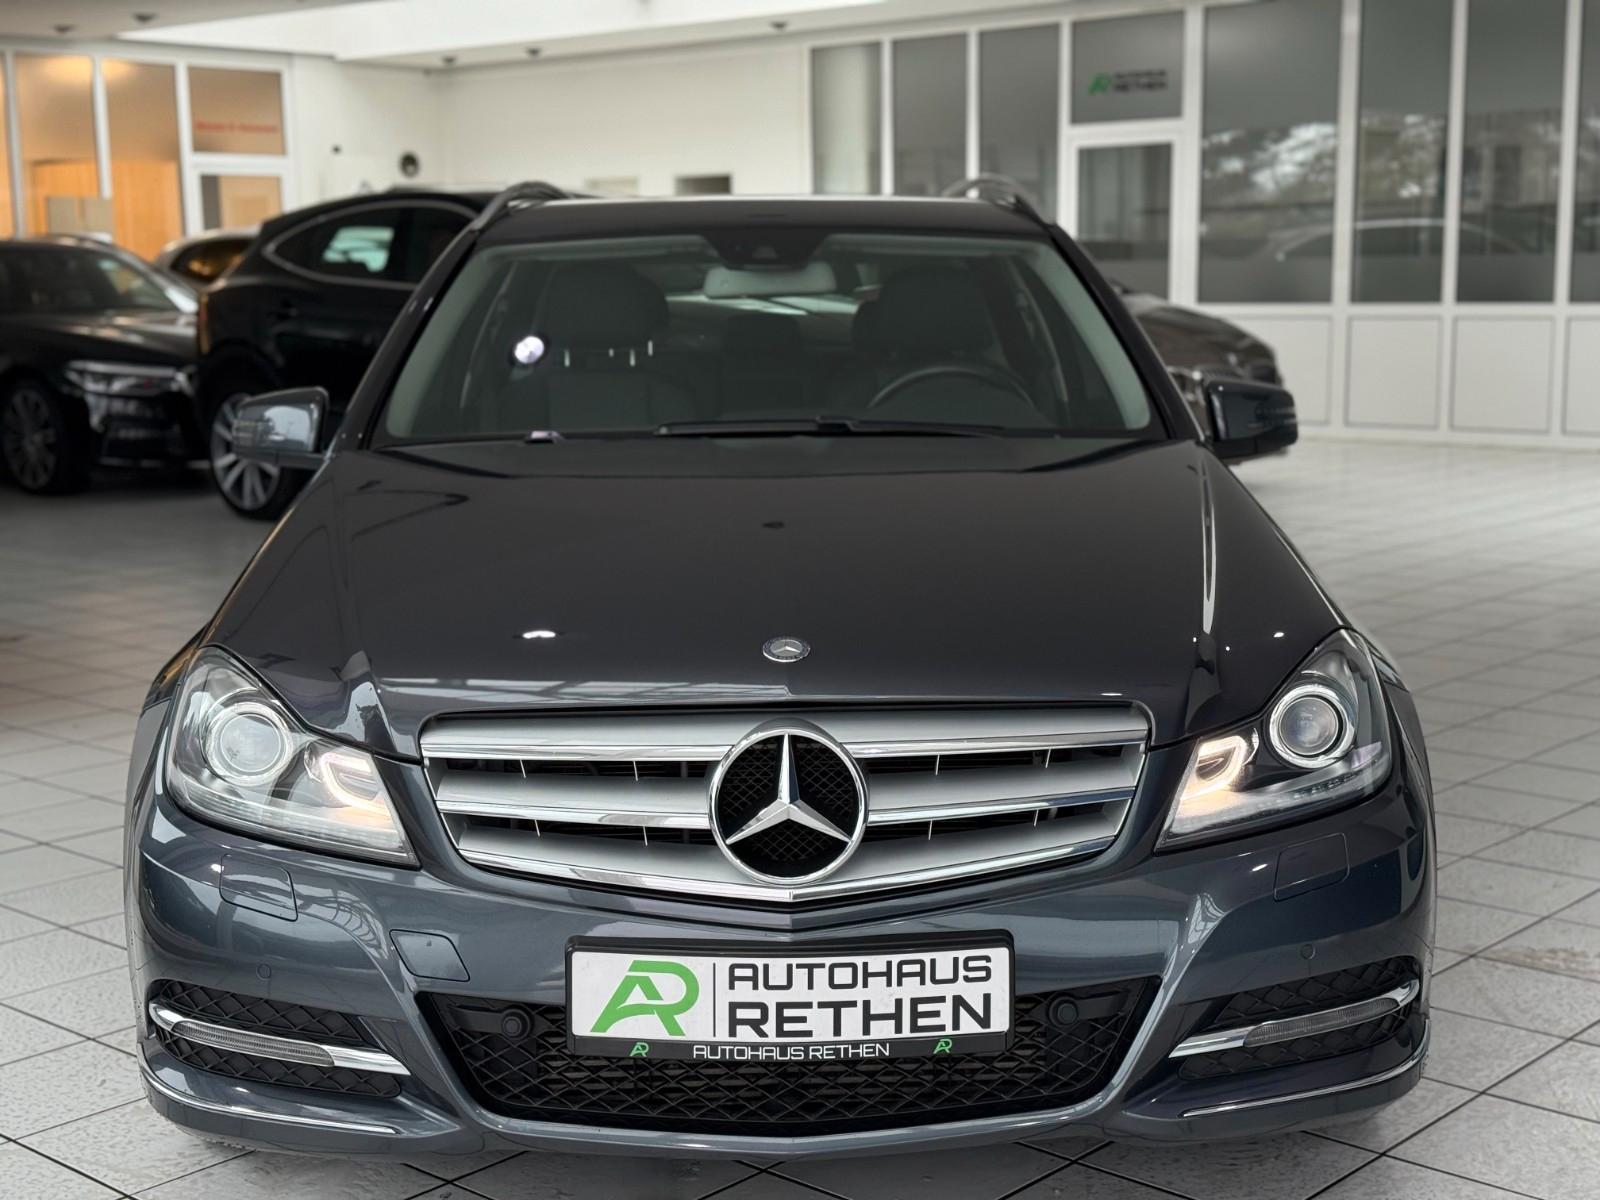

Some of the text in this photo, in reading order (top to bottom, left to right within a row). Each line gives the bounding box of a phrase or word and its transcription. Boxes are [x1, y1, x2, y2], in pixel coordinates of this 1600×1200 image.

[728, 955, 992, 991] AUTOHAUS
[728, 993, 992, 1038] RETHEN
[693, 1043, 890, 1060] AUTOHAUS RETHEN
